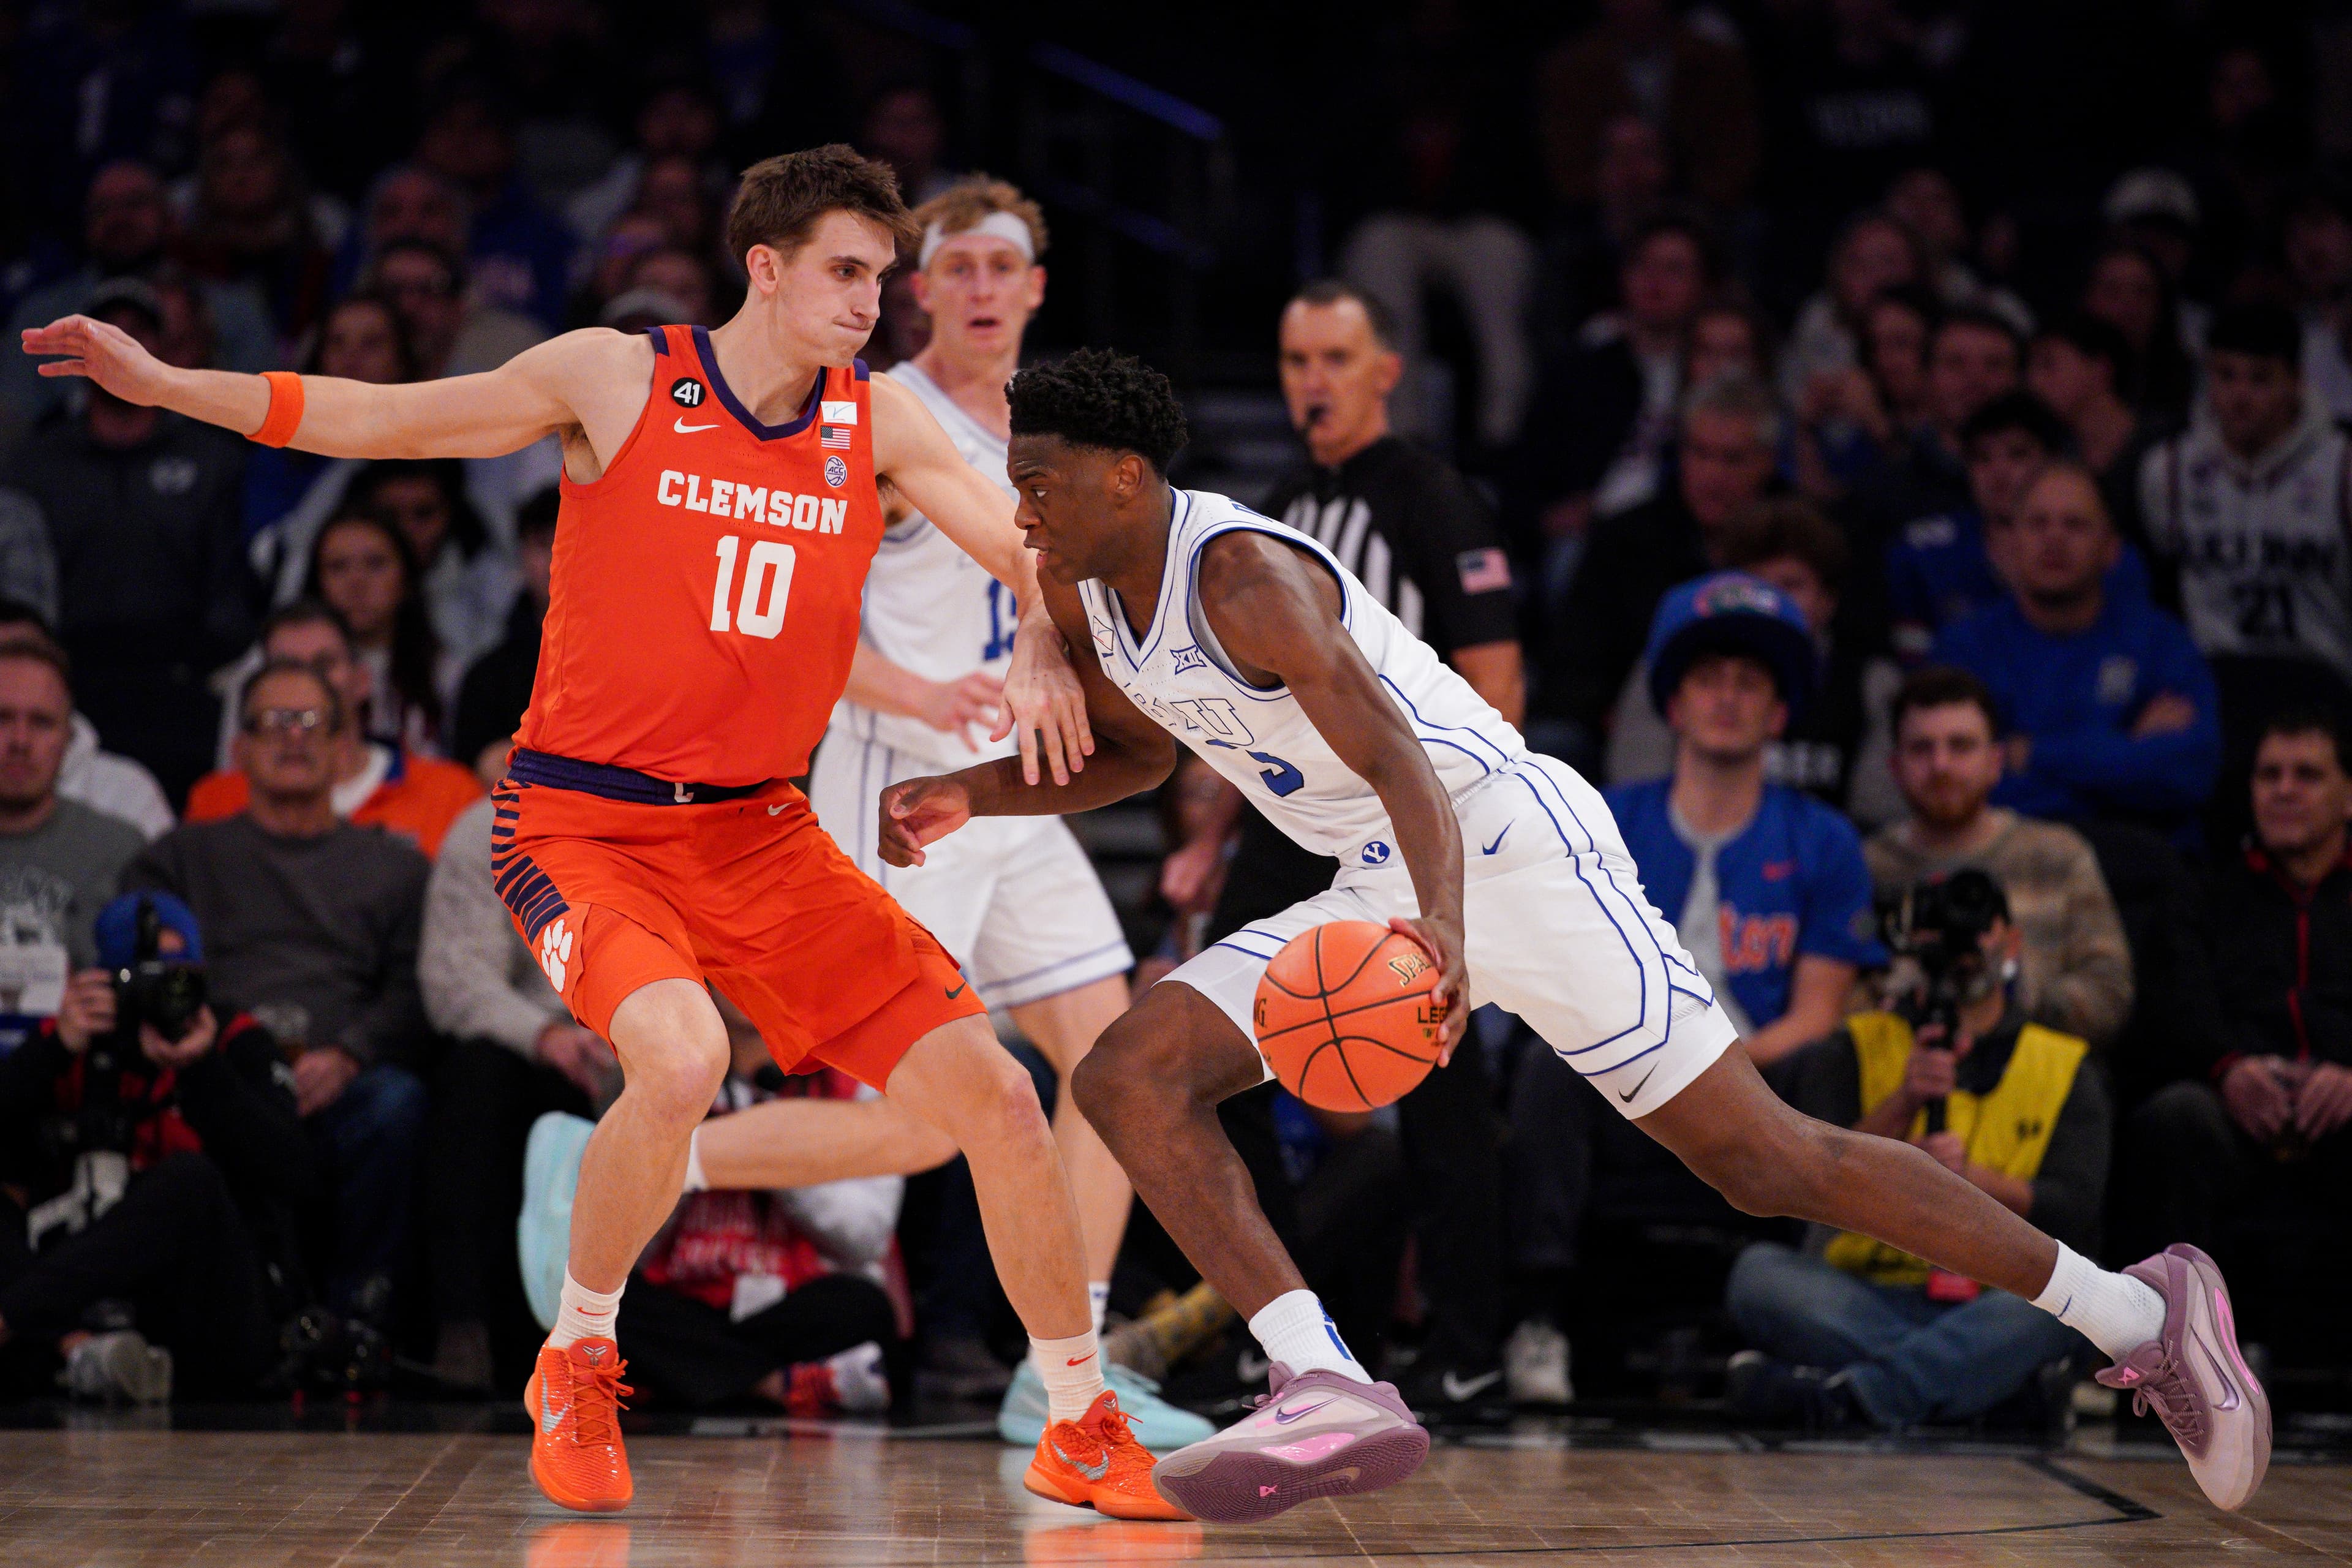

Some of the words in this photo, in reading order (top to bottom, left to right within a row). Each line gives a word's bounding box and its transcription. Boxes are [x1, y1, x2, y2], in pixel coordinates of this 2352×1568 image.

[674, 382, 700, 405] 41
[657, 469, 848, 534] CLEMSON
[710, 535, 796, 639] 10
[984, 578, 1017, 661] 1
[1363, 843, 1385, 862] Y
